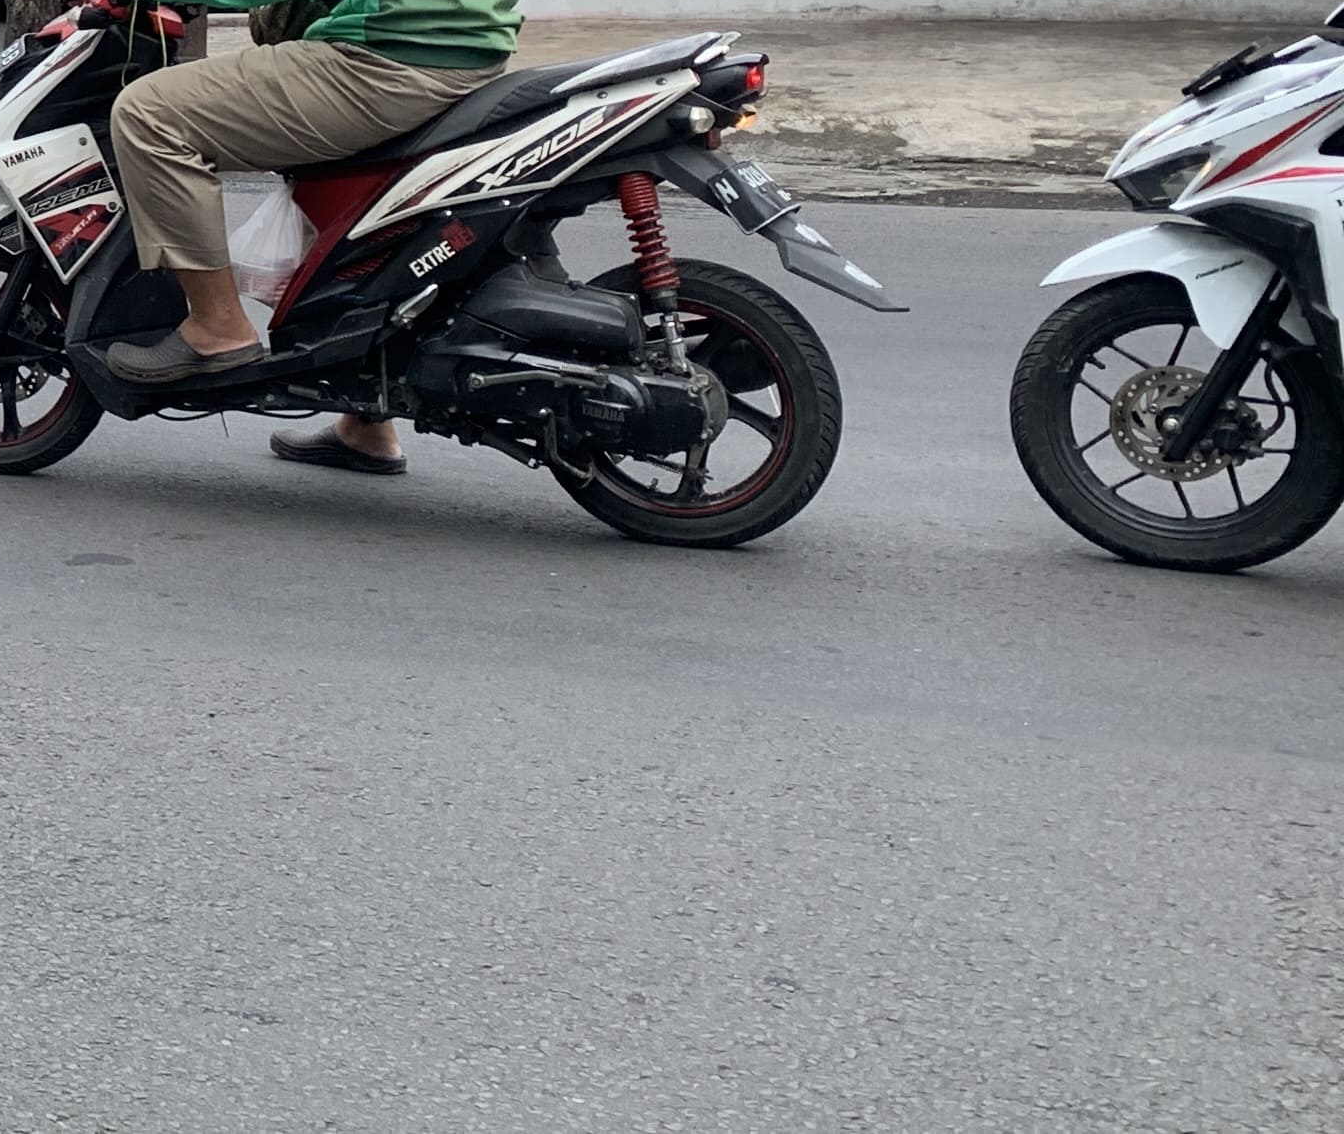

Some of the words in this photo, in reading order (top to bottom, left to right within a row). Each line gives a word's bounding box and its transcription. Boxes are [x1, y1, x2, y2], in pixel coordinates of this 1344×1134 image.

[2, 145, 46, 169] YAMAHA
[476, 105, 608, 194] X-RIDE
[714, 177, 740, 204] N
